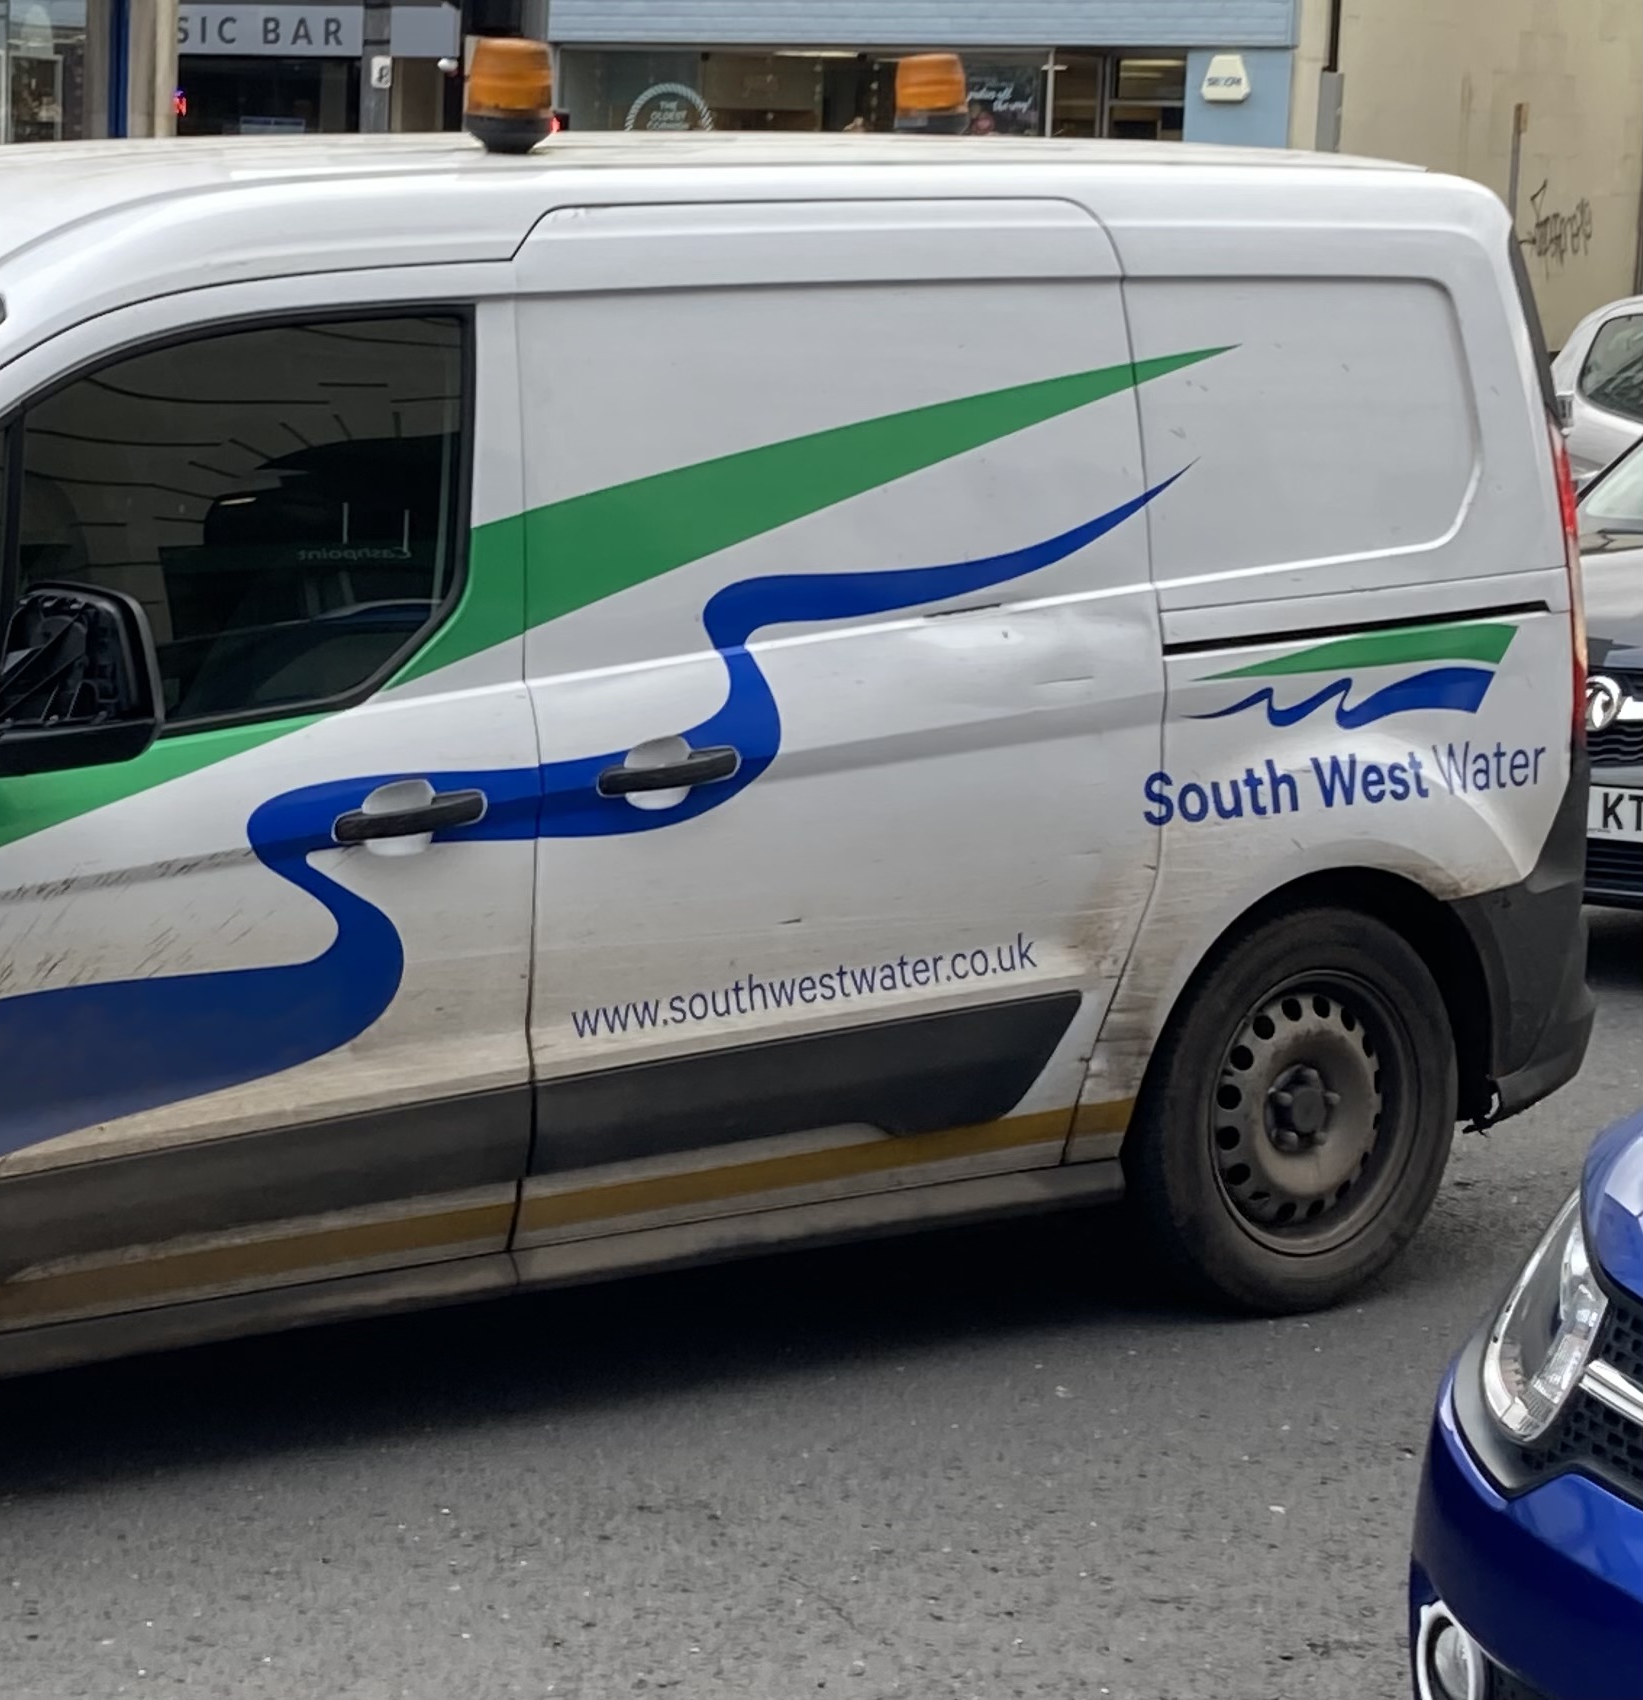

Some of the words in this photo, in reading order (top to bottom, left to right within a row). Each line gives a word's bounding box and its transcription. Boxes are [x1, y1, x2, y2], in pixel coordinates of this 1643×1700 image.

[262, 16, 343, 46] BAR
[1143, 758, 1299, 827] South
[1311, 751, 1430, 809] West
[1432, 740, 1547, 796] Water
[571, 932, 1038, 1038] www.southwestwater.co.uk
